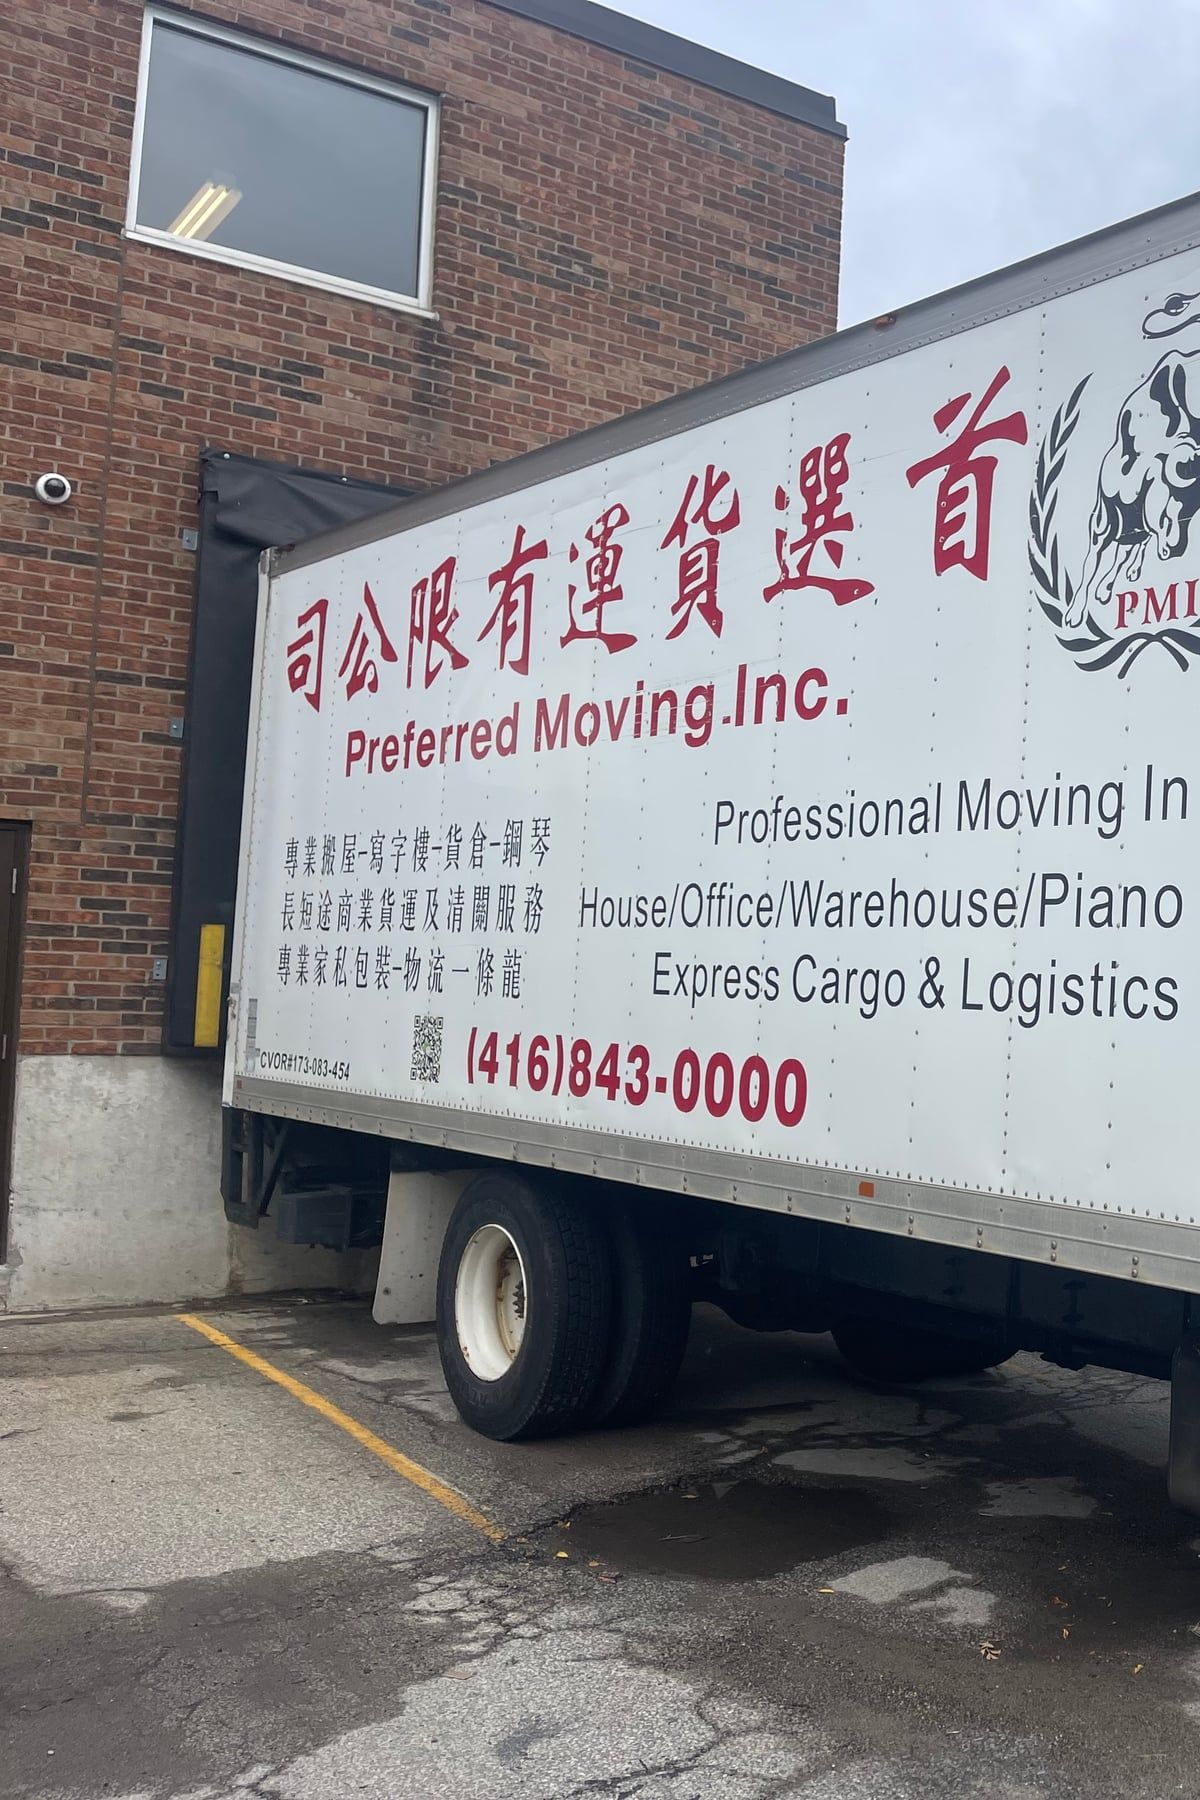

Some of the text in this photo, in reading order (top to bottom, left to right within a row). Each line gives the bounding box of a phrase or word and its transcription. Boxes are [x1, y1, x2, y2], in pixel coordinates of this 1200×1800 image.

[1115, 579, 1200, 630] PMI
[345, 703, 519, 777] Preferred
[713, 764, 1188, 846] Professional Moving In
[579, 872, 1183, 929] House/Office/Warehouse/Piano
[653, 951, 1180, 1029] Express Cargo & Logistics
[260, 1051, 350, 1080] CVOR#173-083-454
[466, 1027, 808, 1128] (416)843-0000
